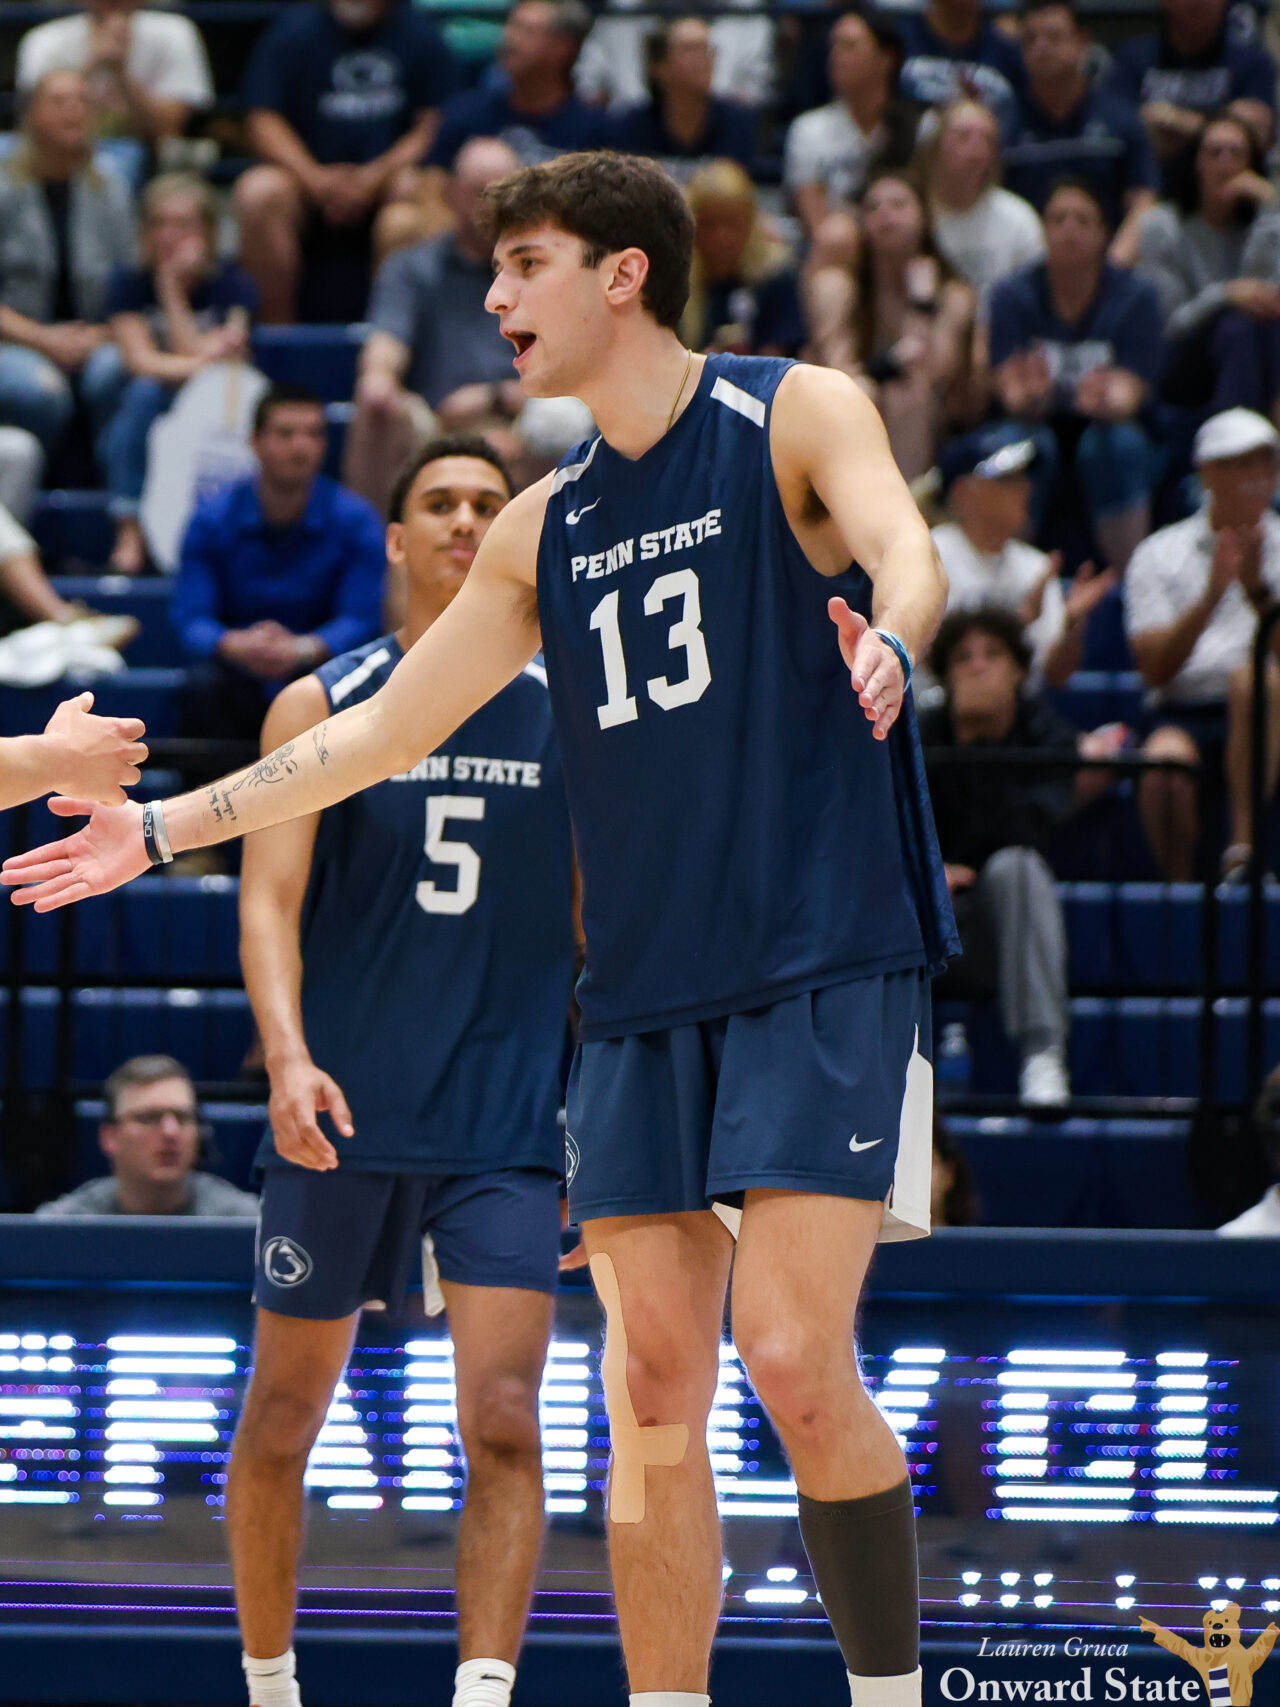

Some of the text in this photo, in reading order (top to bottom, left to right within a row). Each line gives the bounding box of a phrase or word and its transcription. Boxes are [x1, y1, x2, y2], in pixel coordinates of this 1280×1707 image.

[571, 508, 722, 583] PENN STATE
[589, 567, 712, 730] 13
[453, 755, 541, 787] STATE
[415, 795, 485, 915] 5
